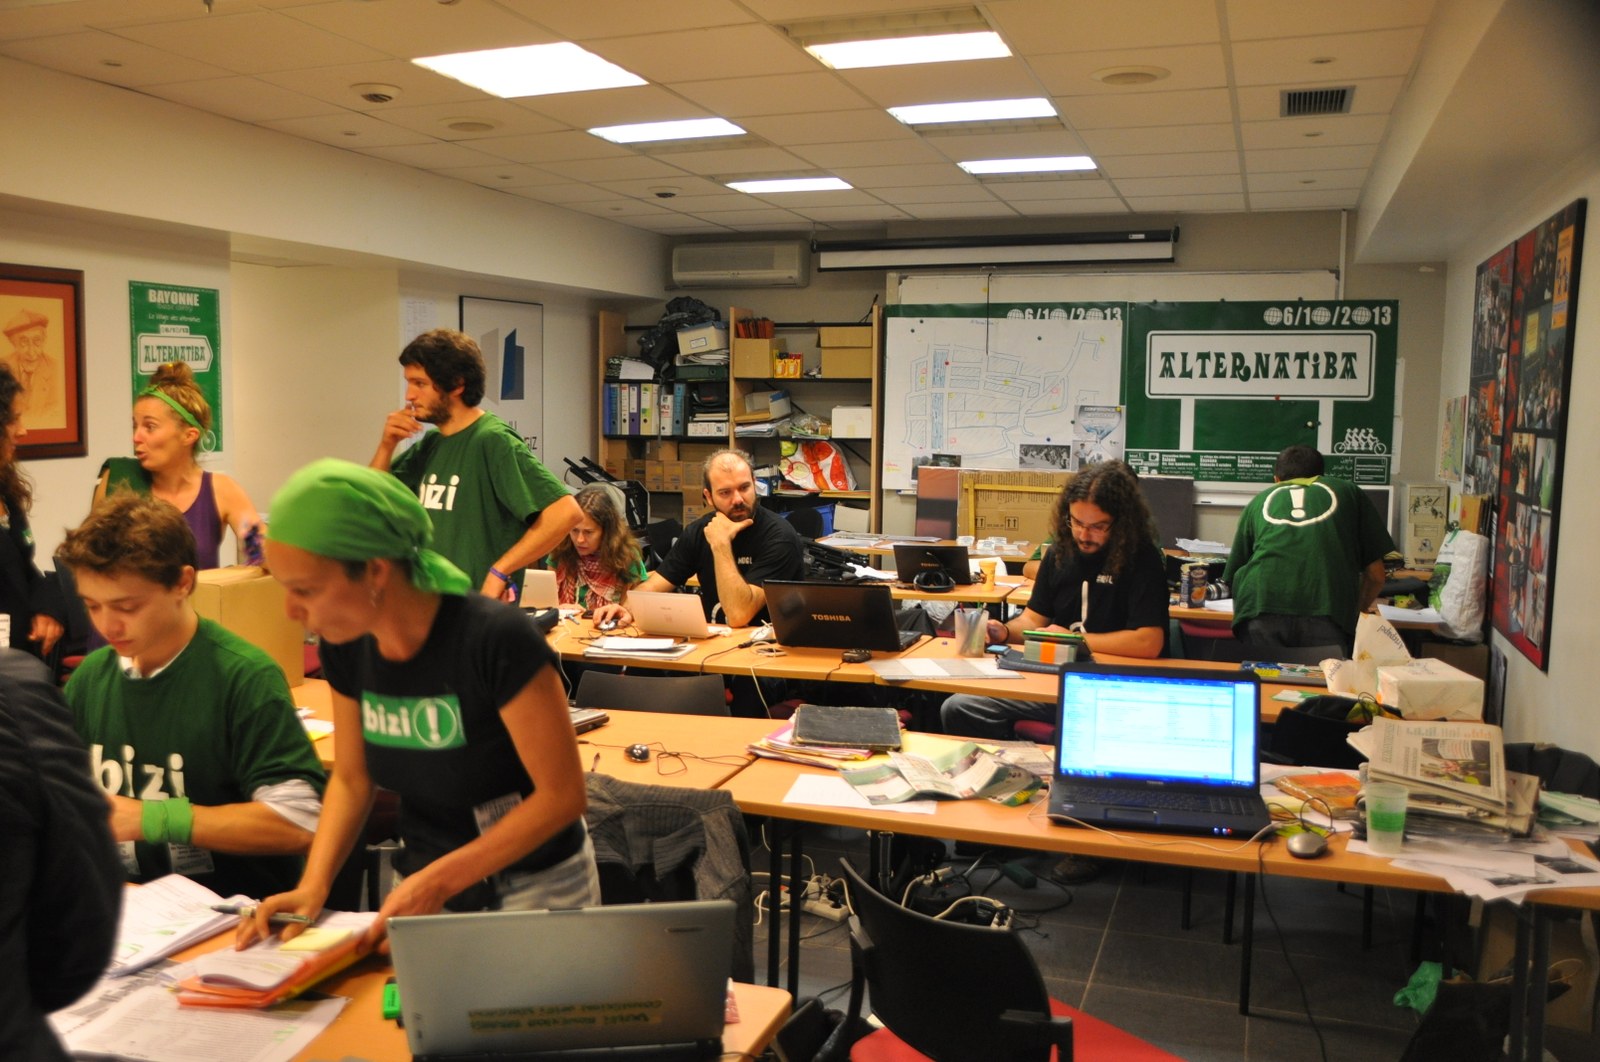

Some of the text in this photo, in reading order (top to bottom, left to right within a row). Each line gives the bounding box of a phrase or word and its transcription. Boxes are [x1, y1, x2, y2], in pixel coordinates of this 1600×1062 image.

[149, 289, 200, 306] BAYONNE
[811, 613, 852, 622] TOSHIBA
[90, 743, 186, 801] bizi
